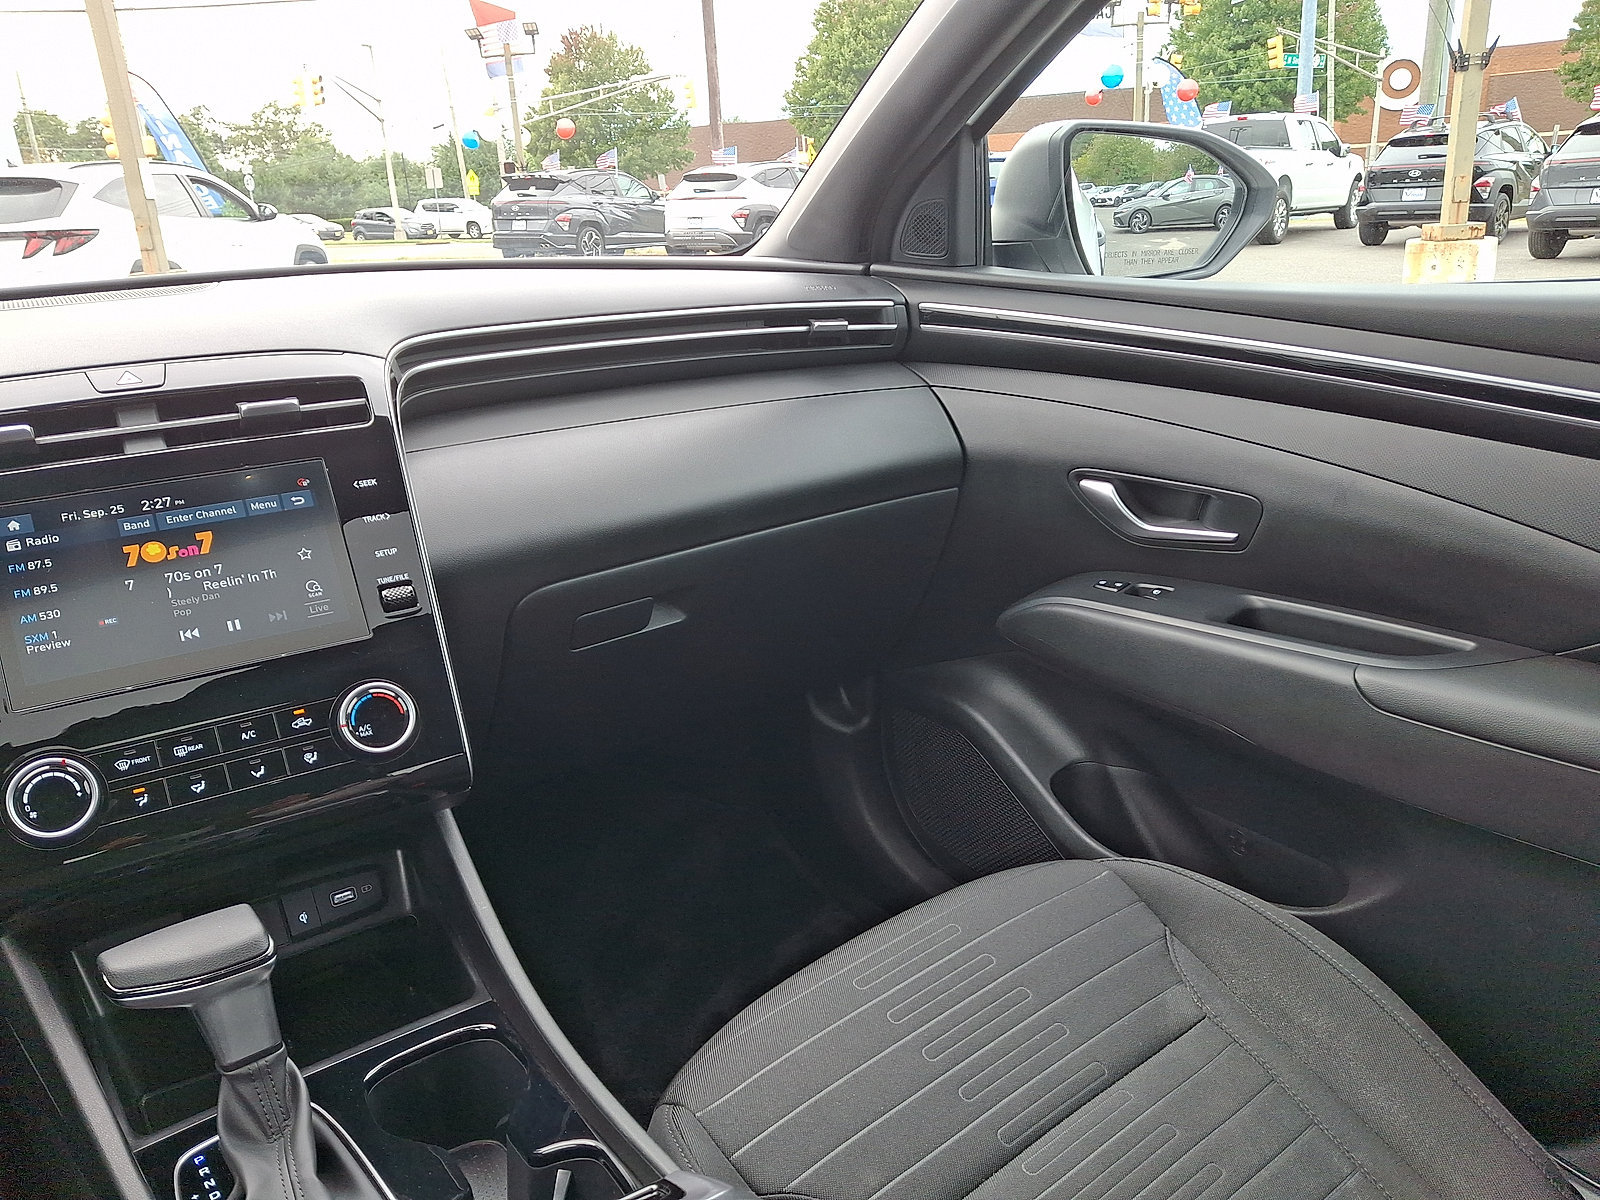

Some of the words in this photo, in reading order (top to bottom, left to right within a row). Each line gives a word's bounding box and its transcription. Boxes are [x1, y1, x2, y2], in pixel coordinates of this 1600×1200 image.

[1104, 250, 1128, 259] OBJECTS
[1140, 249, 1161, 257] MIRROR
[1163, 248, 1174, 256] ARE
[1178, 247, 1199, 256] CLOSER
[1124, 258, 1137, 266] THAN
[1141, 257, 1154, 265] THEY
[1157, 256, 1179, 264] APPEAR
[140, 496, 171, 511] 2:27
[250, 499, 277, 511] Menu
[82, 507, 108, 520] Sep.
[109, 504, 125, 515] 25
[166, 512, 194, 524] Enter
[195, 505, 237, 520] Channel
[123, 519, 151, 531] Band
[25, 534, 60, 547] Radio
[374, 547, 398, 558] SETUP
[8, 563, 26, 574] FM
[27, 558, 53, 571] 87.5
[164, 570, 191, 584] 70s
[194, 567, 211, 578] on
[213, 563, 223, 575] 7
[203, 573, 245, 591] Reelin'
[248, 574, 260, 583] In
[260, 568, 278, 580] Th
[376, 572, 410, 585] TUNE/FILE
[13, 588, 31, 599] FM
[33, 583, 58, 596] 89.5
[124, 579, 134, 591] 7
[171, 595, 200, 608] Steely
[201, 591, 221, 602] Dan
[173, 608, 192, 619] Pop
[309, 604, 329, 615] Live
[20, 613, 38, 625] AM
[38, 609, 61, 622] 530
[104, 617, 117, 625] REC
[24, 632, 49, 645] SXM
[51, 630, 58, 640] 1
[26, 639, 71, 655] Preview
[358, 723, 372, 732] A/C
[359, 729, 374, 738] MAX
[241, 730, 257, 741] A/C
[187, 743, 204, 752] REAR
[131, 755, 151, 766] FRONT
[194, 1155, 205, 1165] P
[199, 1166, 210, 1177] R
[203, 1178, 216, 1190] N
